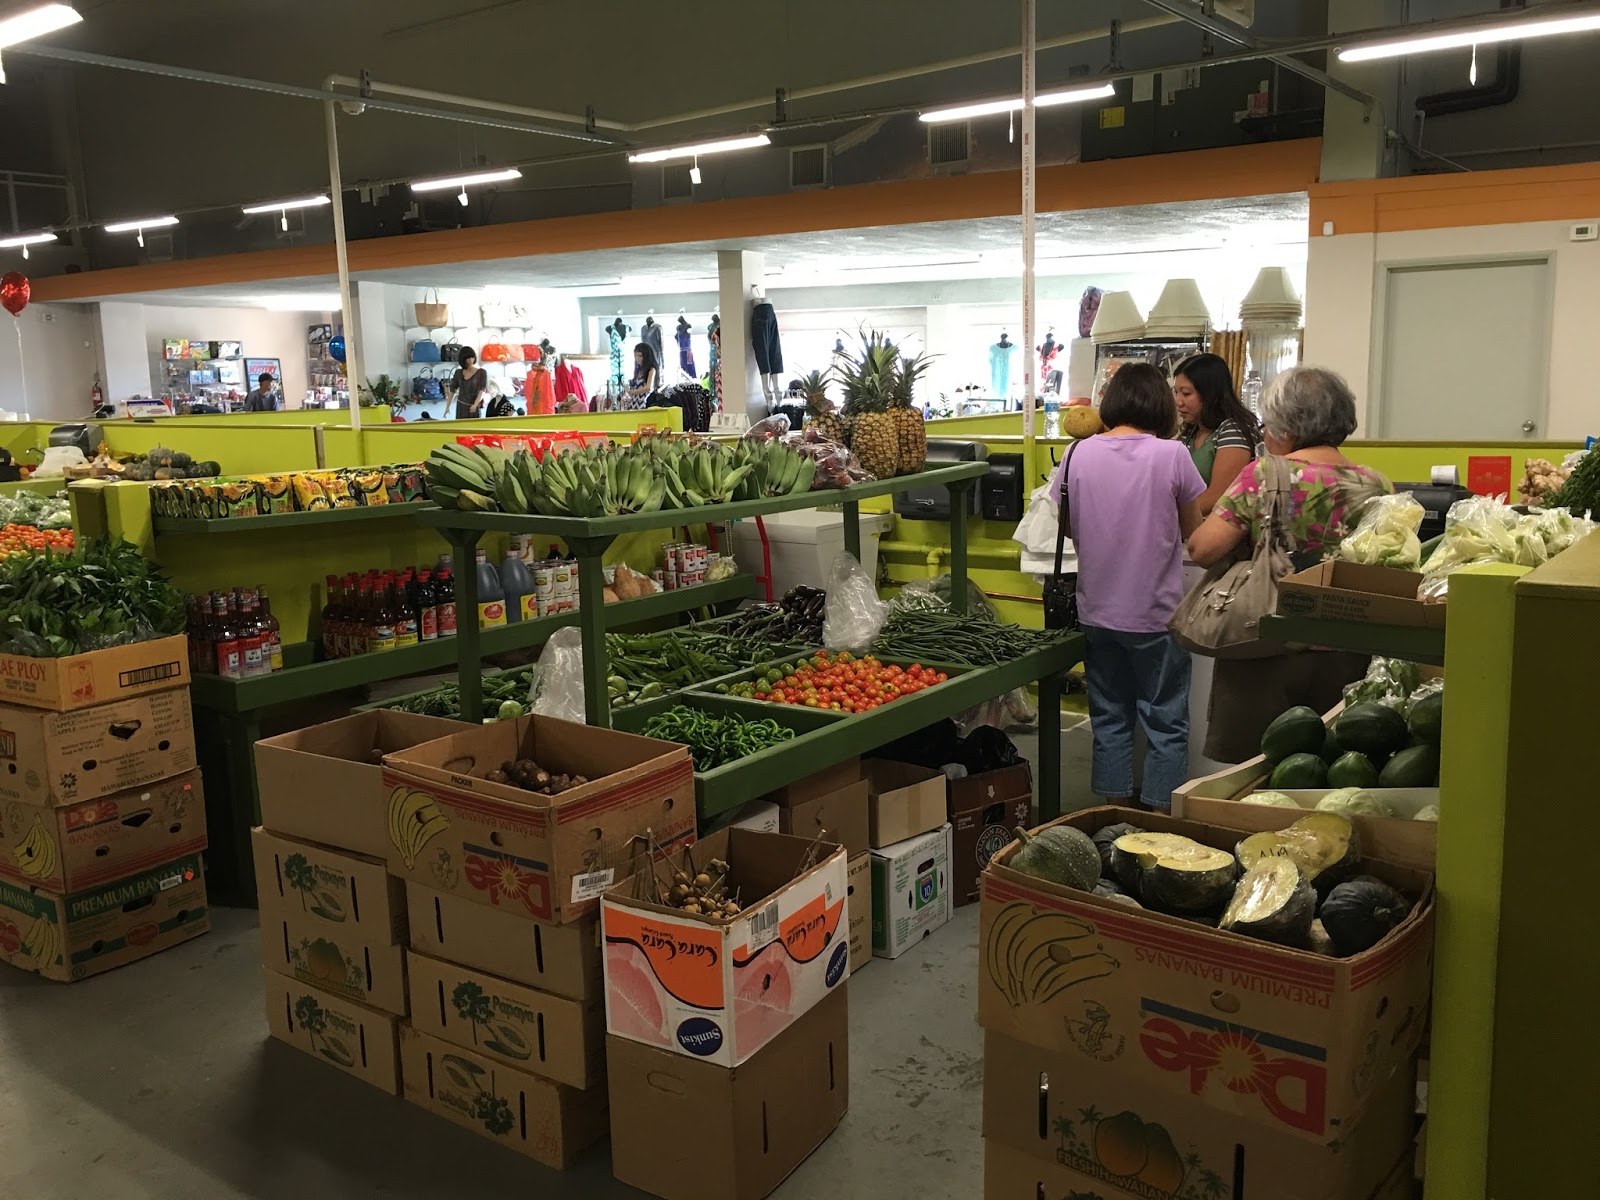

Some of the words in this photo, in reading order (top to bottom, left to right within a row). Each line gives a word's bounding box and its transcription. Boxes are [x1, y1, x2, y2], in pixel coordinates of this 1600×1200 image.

[1322, 593, 1345, 603] PASTA
[0, 659, 14, 677] AE
[17, 661, 46, 681] PLOY
[451, 775, 473, 787] PACKER
[454, 808, 498, 829] BANANAS
[498, 819, 547, 838] PREMIUM
[69, 825, 121, 845] BANANAS
[314, 864, 347, 890] Papaya
[464, 854, 552, 922] Dole
[72, 884, 136, 918] PREMIUM
[924, 884, 931, 898] 10
[641, 933, 677, 961] Cara
[679, 942, 718, 967] Cara
[1135, 946, 1226, 982] BANANAS
[1230, 971, 1332, 1010] PREMIUM
[325, 1008, 357, 1035] Papaya
[492, 995, 536, 1025] Papaya
[678, 1027, 721, 1046] Sunkist
[1139, 1017, 1327, 1137] Dole
[438, 1089, 476, 1119] Papaya
[1058, 1152, 1097, 1176] FRESH
[1099, 1165, 1171, 1200] HAWAIIAN
